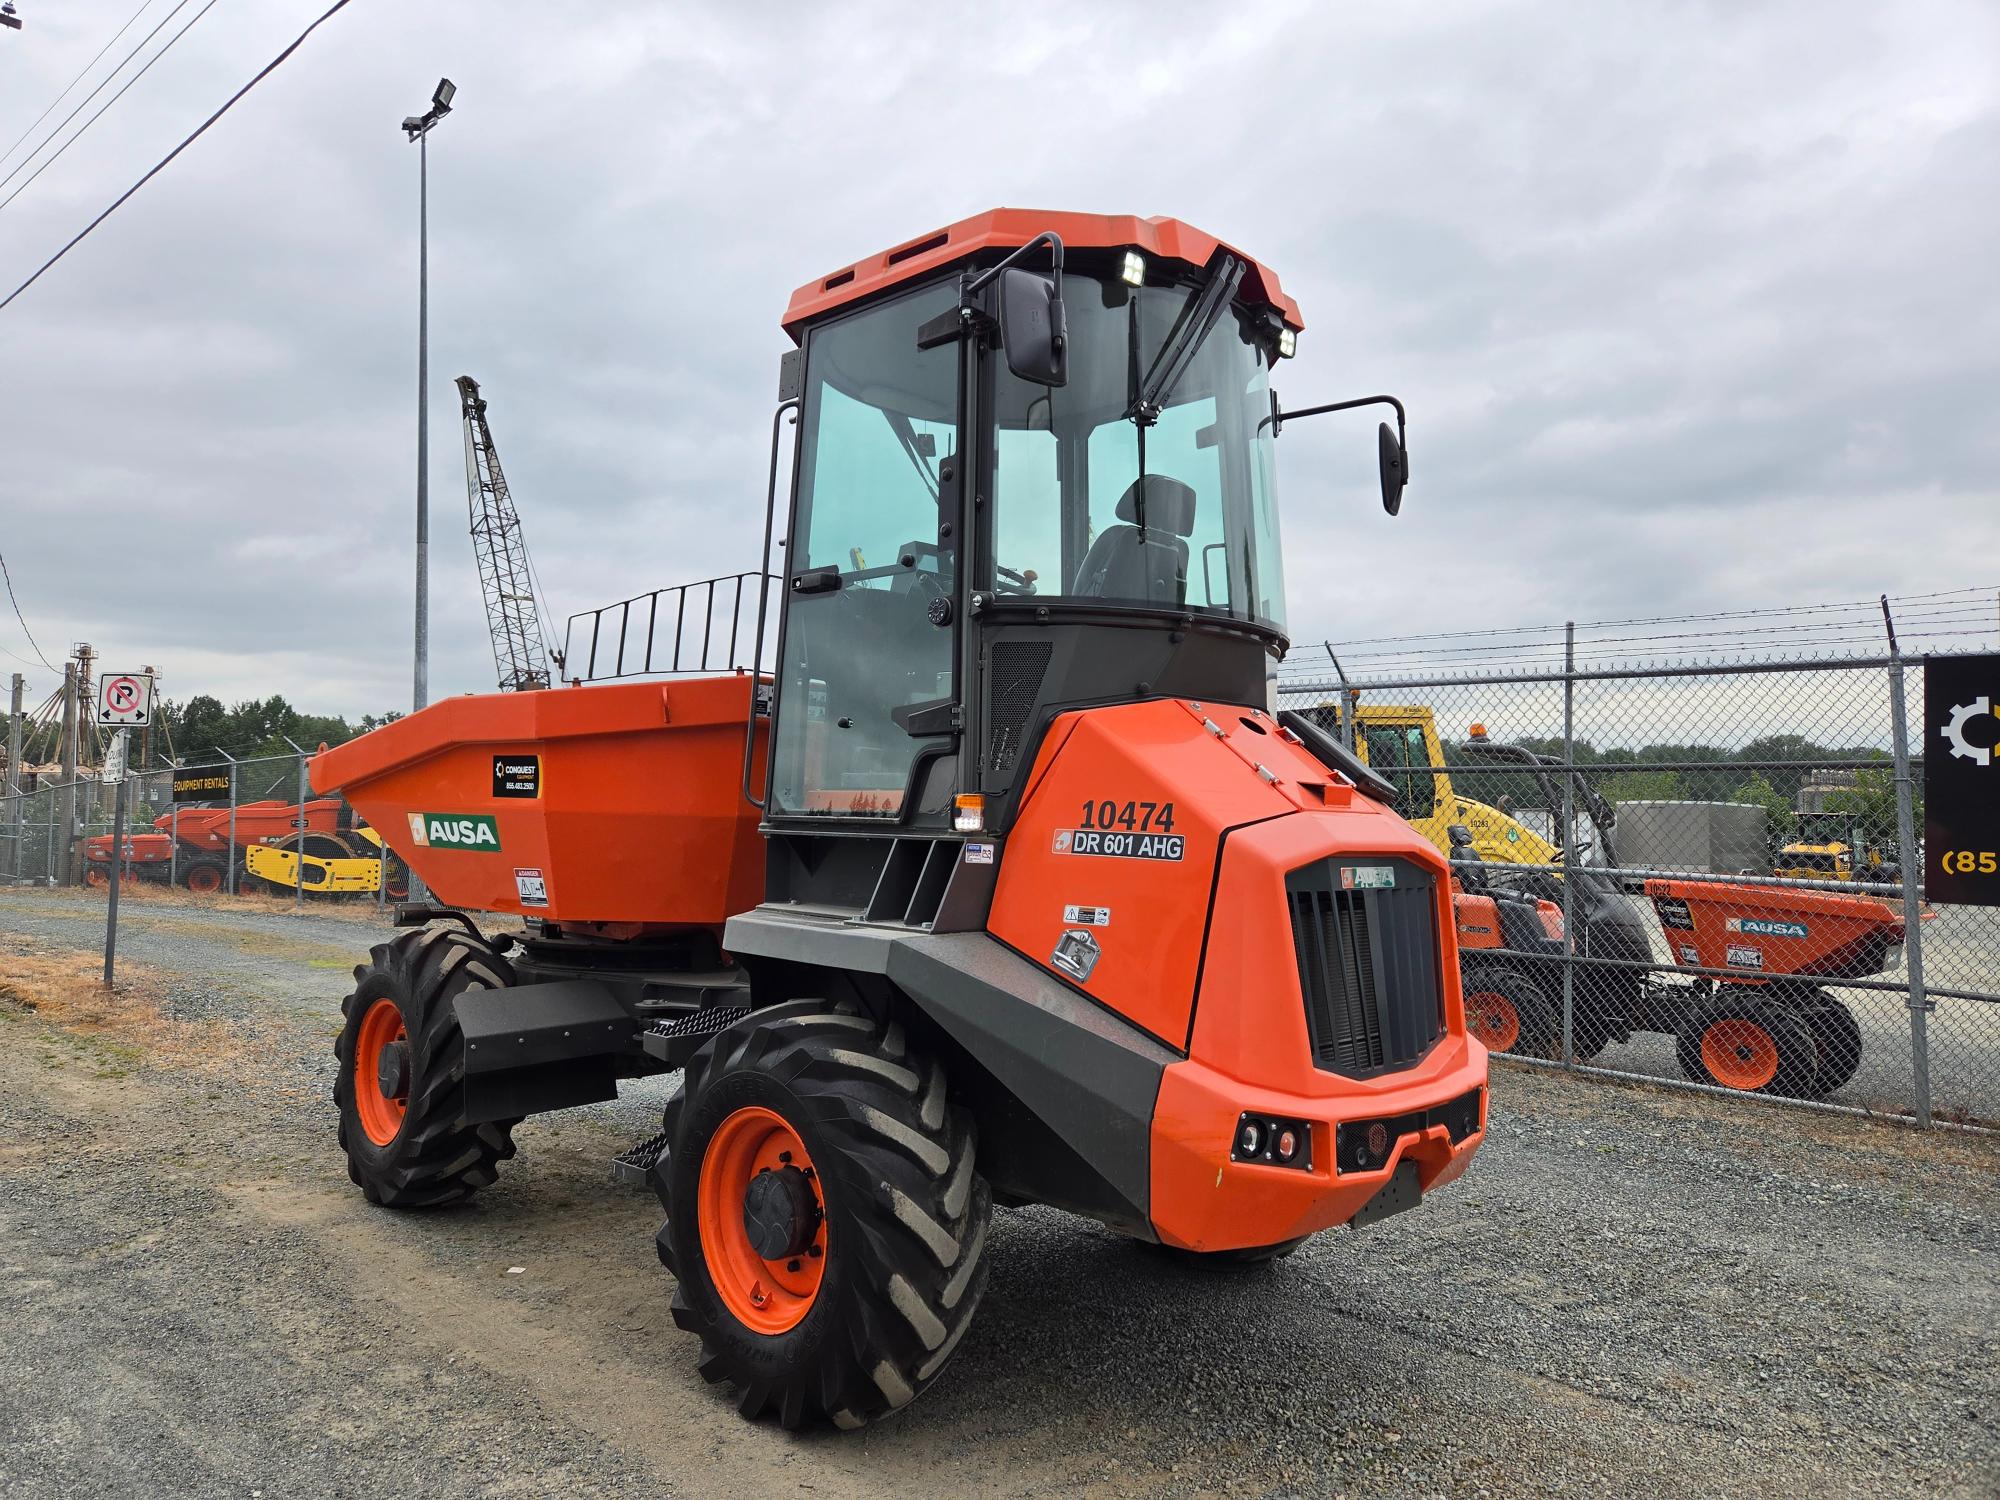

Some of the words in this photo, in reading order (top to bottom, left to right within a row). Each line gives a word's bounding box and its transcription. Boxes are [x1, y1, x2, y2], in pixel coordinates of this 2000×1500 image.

[505, 766, 536, 774] CONQUEST
[174, 778, 203, 792] EQUIPMENT
[204, 777, 229, 790] RENTALS
[1080, 800, 1175, 833] 10474
[430, 820, 497, 845] AUSA
[1073, 832, 1100, 853] DR
[1103, 834, 1134, 855] 601
[1138, 836, 1182, 858] AHG
[1743, 921, 1805, 936] AUSA
